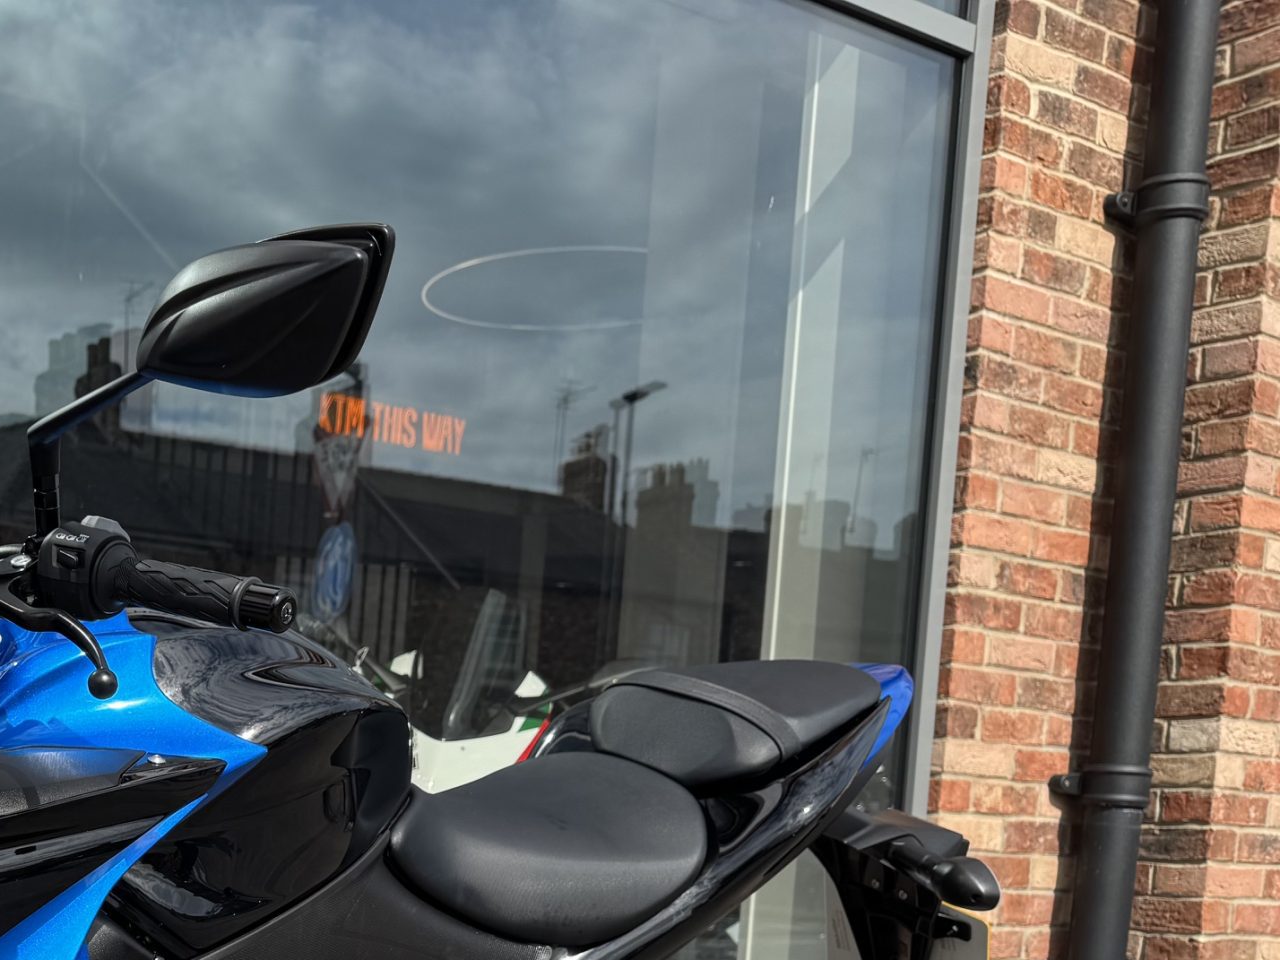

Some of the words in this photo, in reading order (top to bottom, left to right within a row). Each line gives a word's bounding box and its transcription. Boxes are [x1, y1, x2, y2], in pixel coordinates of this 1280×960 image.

[319, 391, 365, 438] KTM
[370, 399, 418, 449] THIS
[421, 410, 466, 456] WAY
